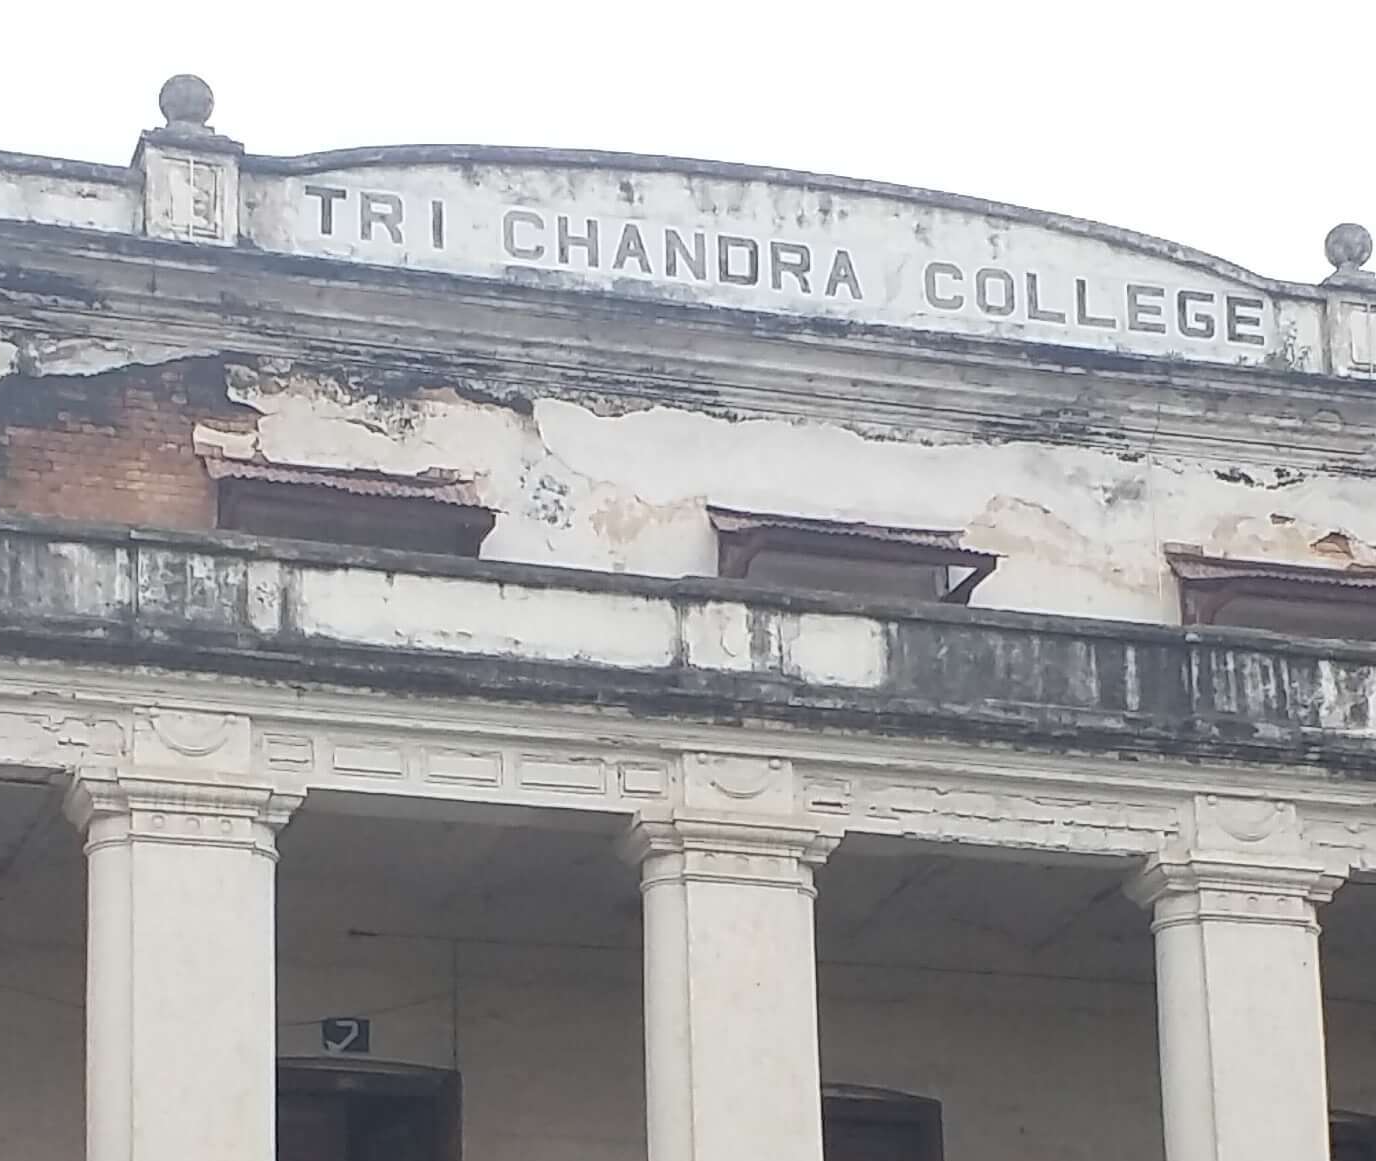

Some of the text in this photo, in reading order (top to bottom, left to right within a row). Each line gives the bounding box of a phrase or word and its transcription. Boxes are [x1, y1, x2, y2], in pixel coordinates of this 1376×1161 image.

[304, 185, 1265, 346] TRI CHANDRA COLLEGE
